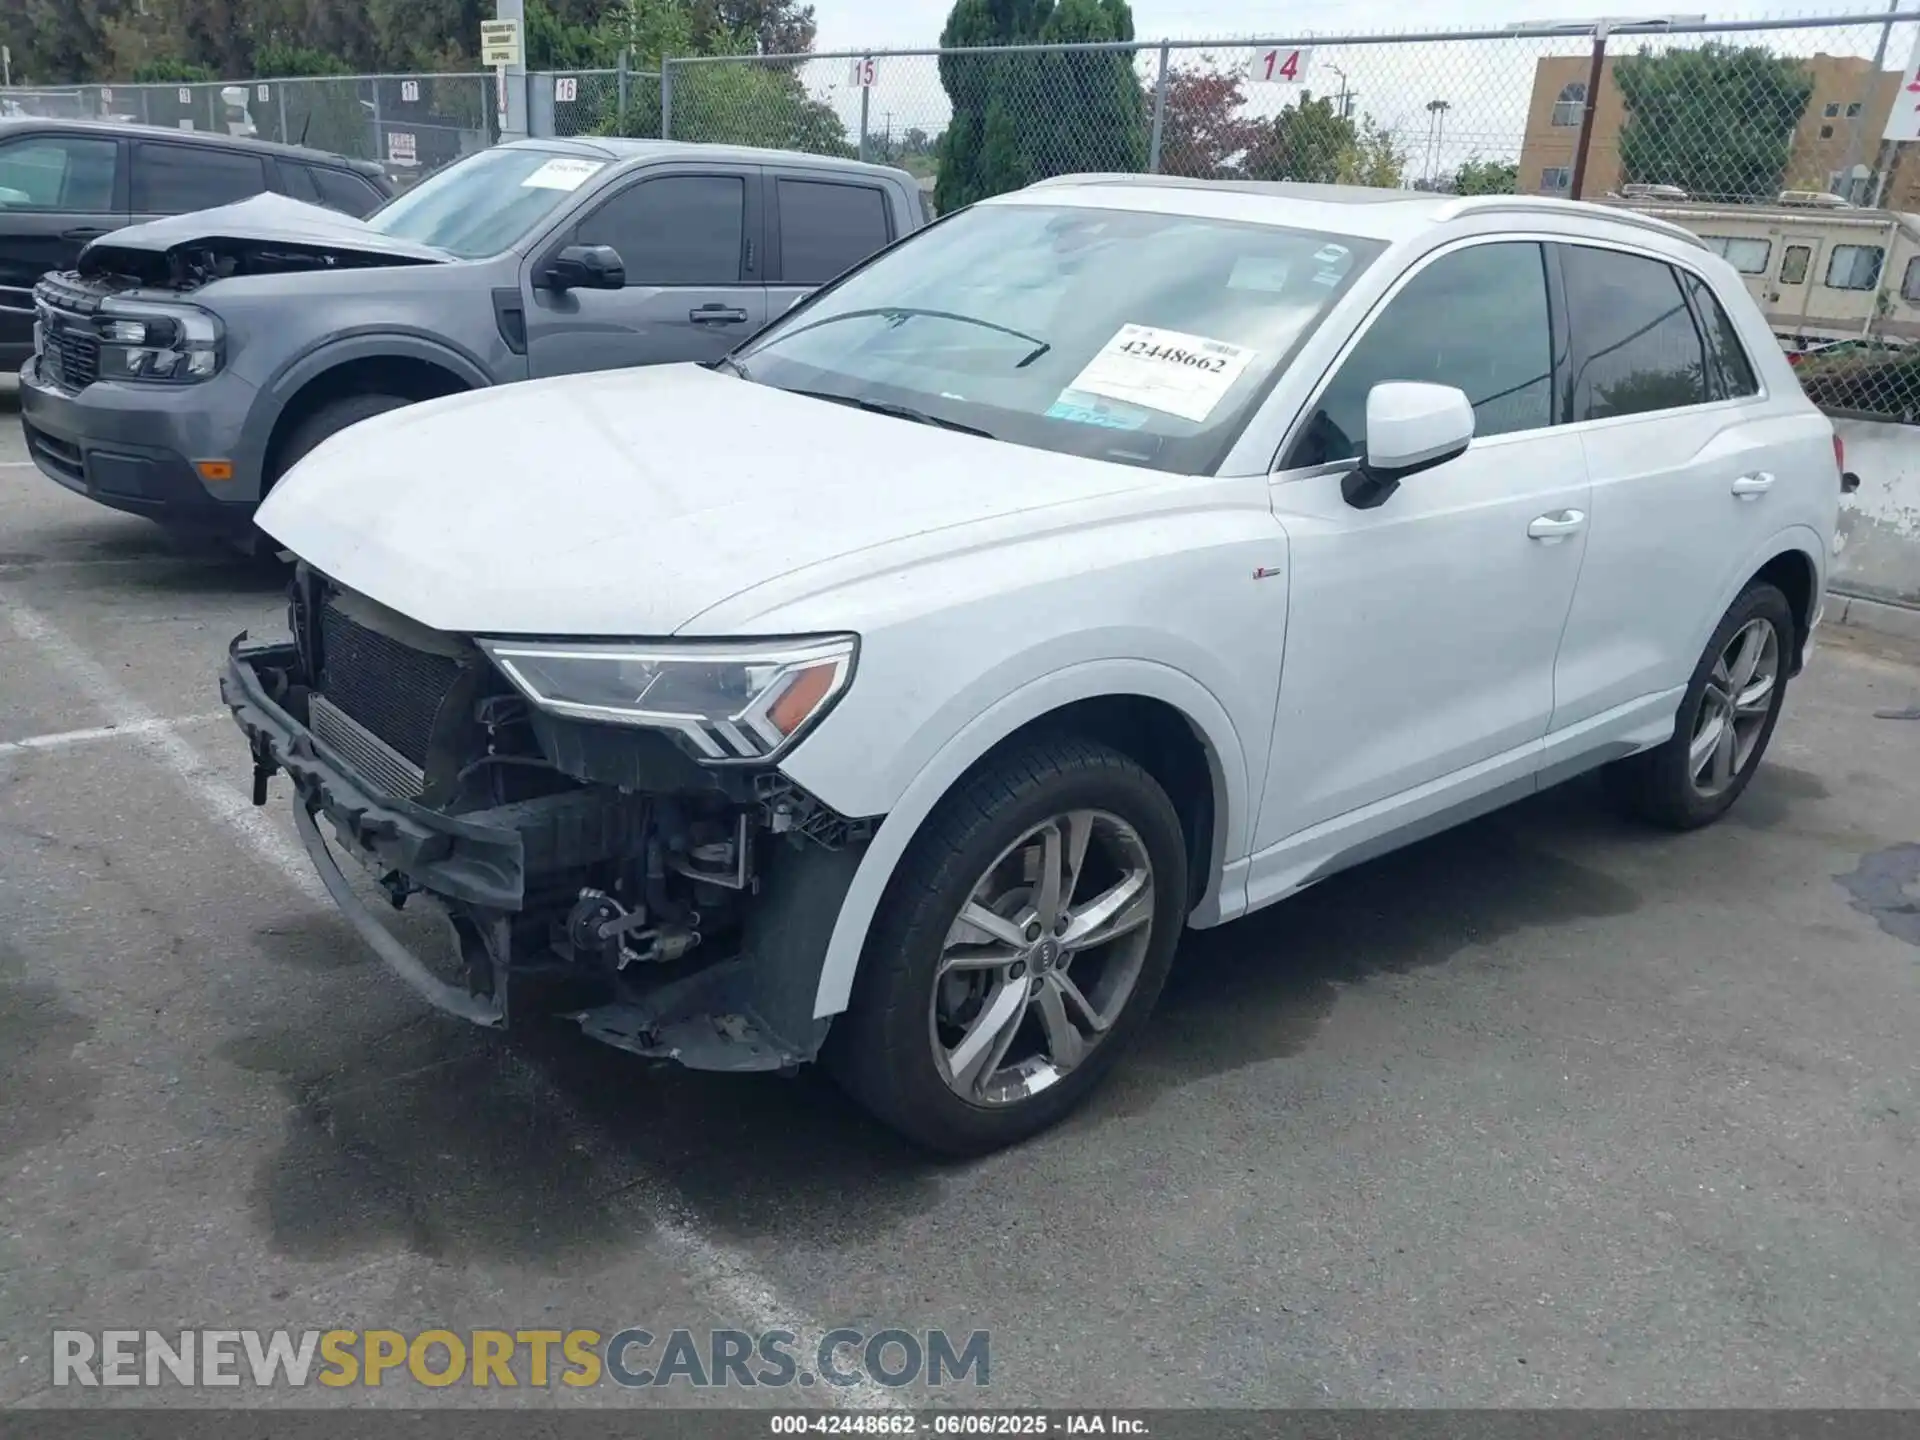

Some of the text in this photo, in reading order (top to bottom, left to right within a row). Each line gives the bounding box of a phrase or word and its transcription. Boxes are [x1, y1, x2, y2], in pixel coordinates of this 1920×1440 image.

[856, 61, 874, 85] 15
[1263, 50, 1300, 81] 14
[559, 80, 574, 99] 16
[1120, 341, 1226, 373] 42448662
